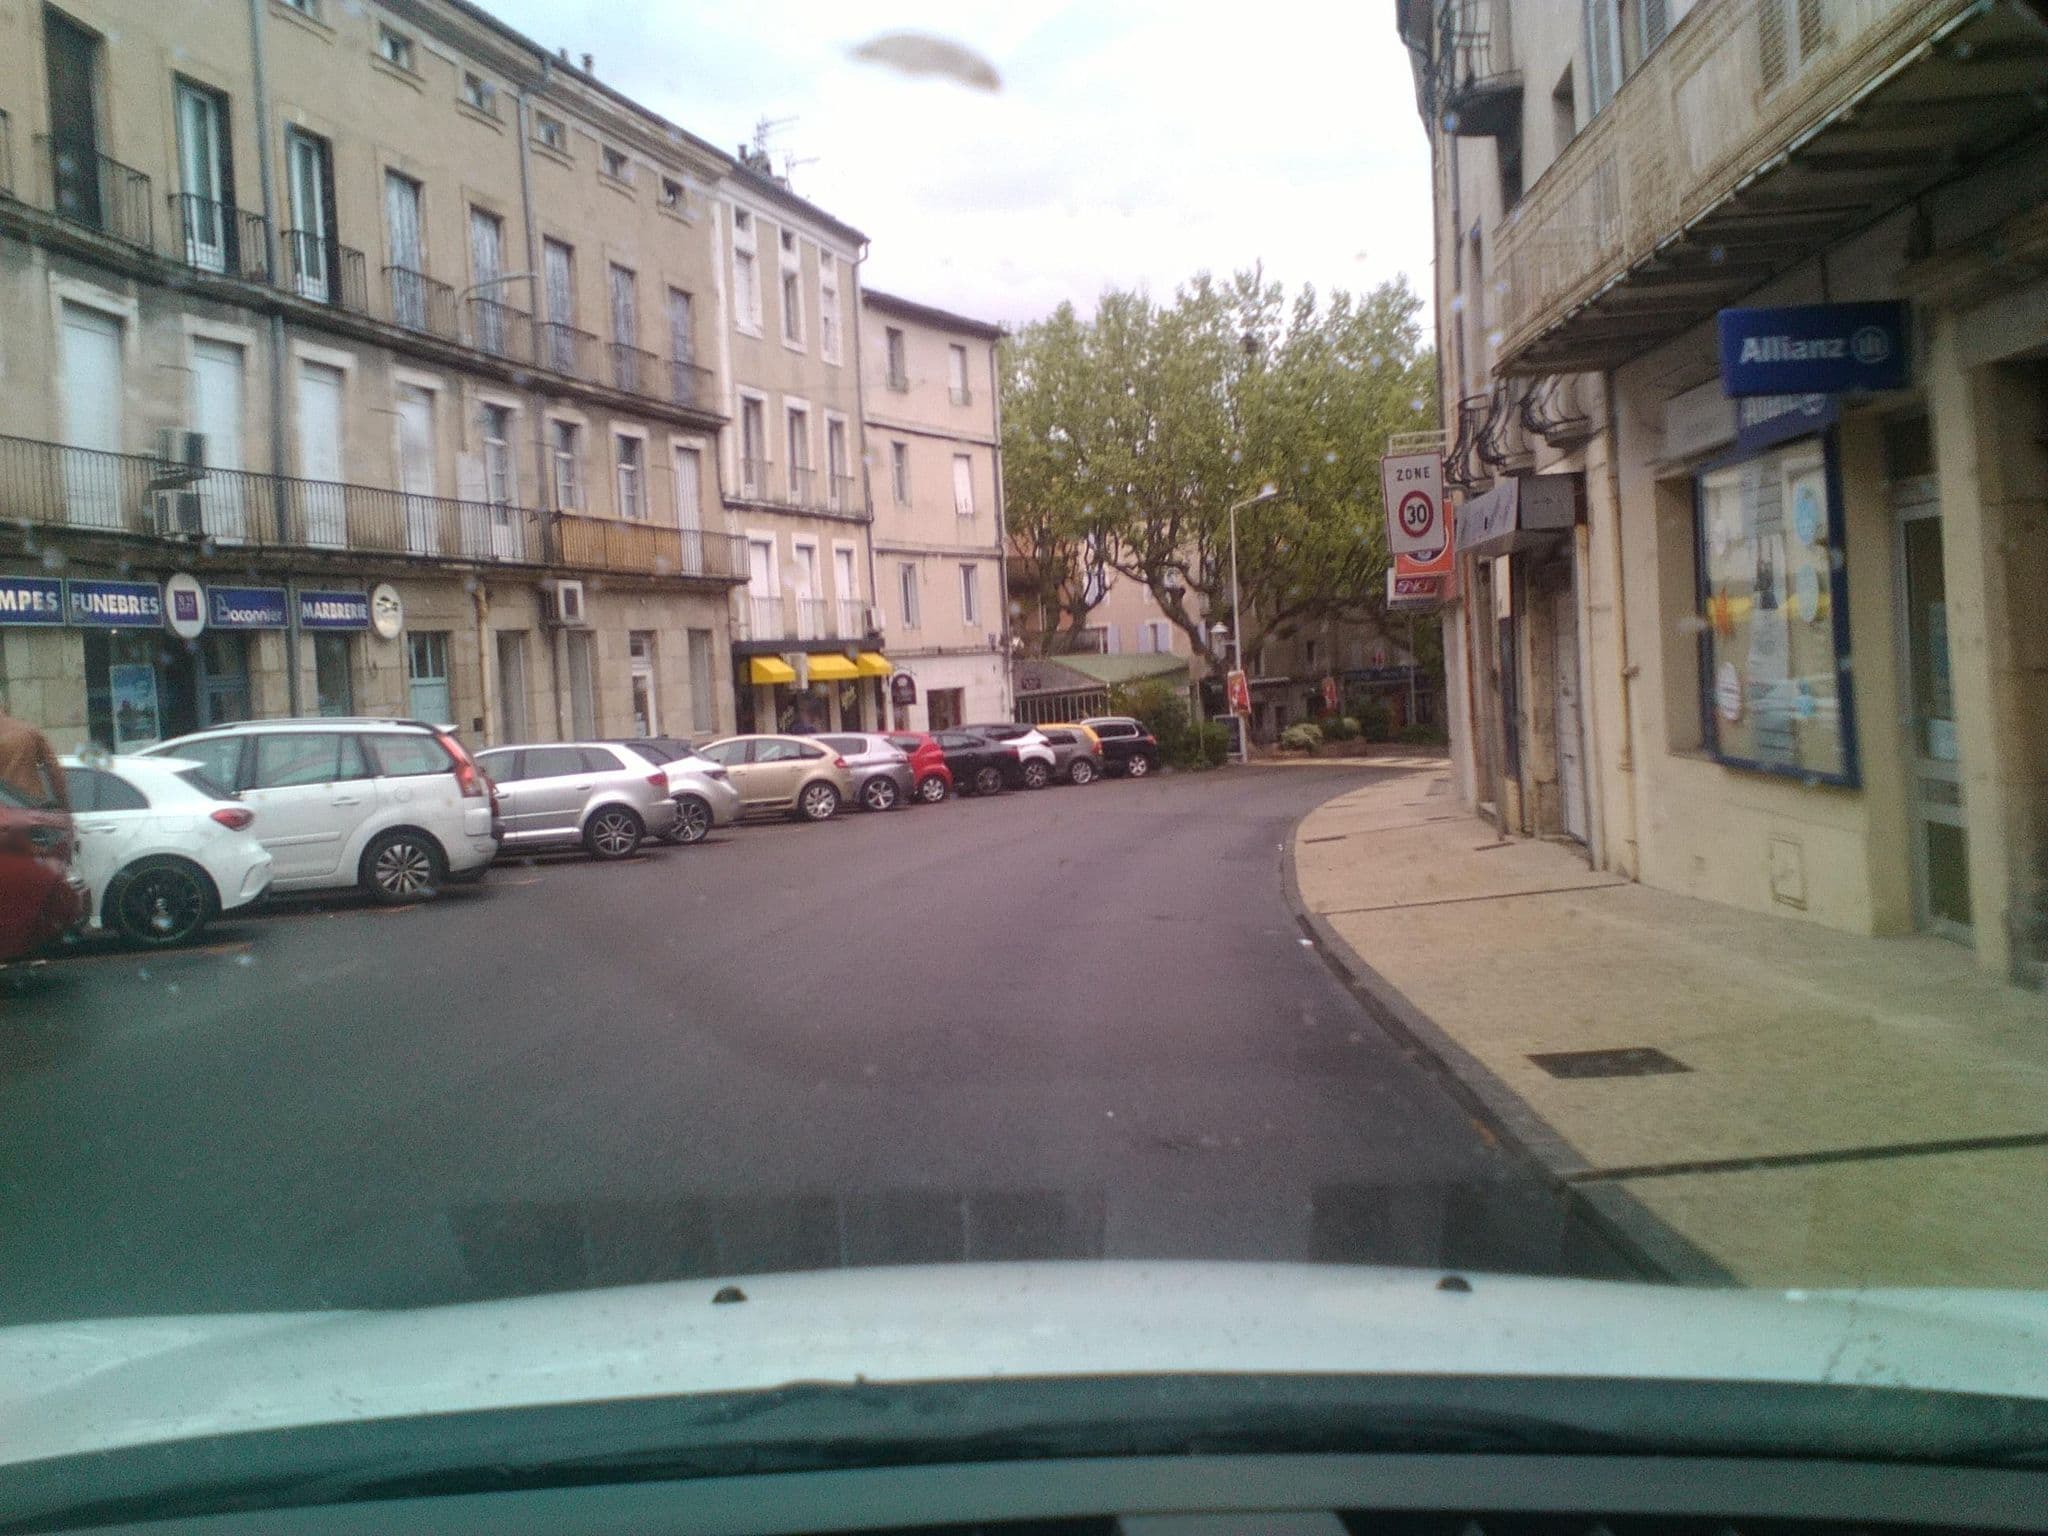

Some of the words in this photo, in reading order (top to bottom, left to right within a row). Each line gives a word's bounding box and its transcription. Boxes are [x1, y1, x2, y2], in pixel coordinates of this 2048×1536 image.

[1740, 335, 1847, 364] Allianz
[1396, 466, 1430, 481] ZONE
[1407, 505, 1428, 525] 30
[71, 592, 160, 615] FUNEBRES
[302, 602, 368, 620] MARBRERIE
